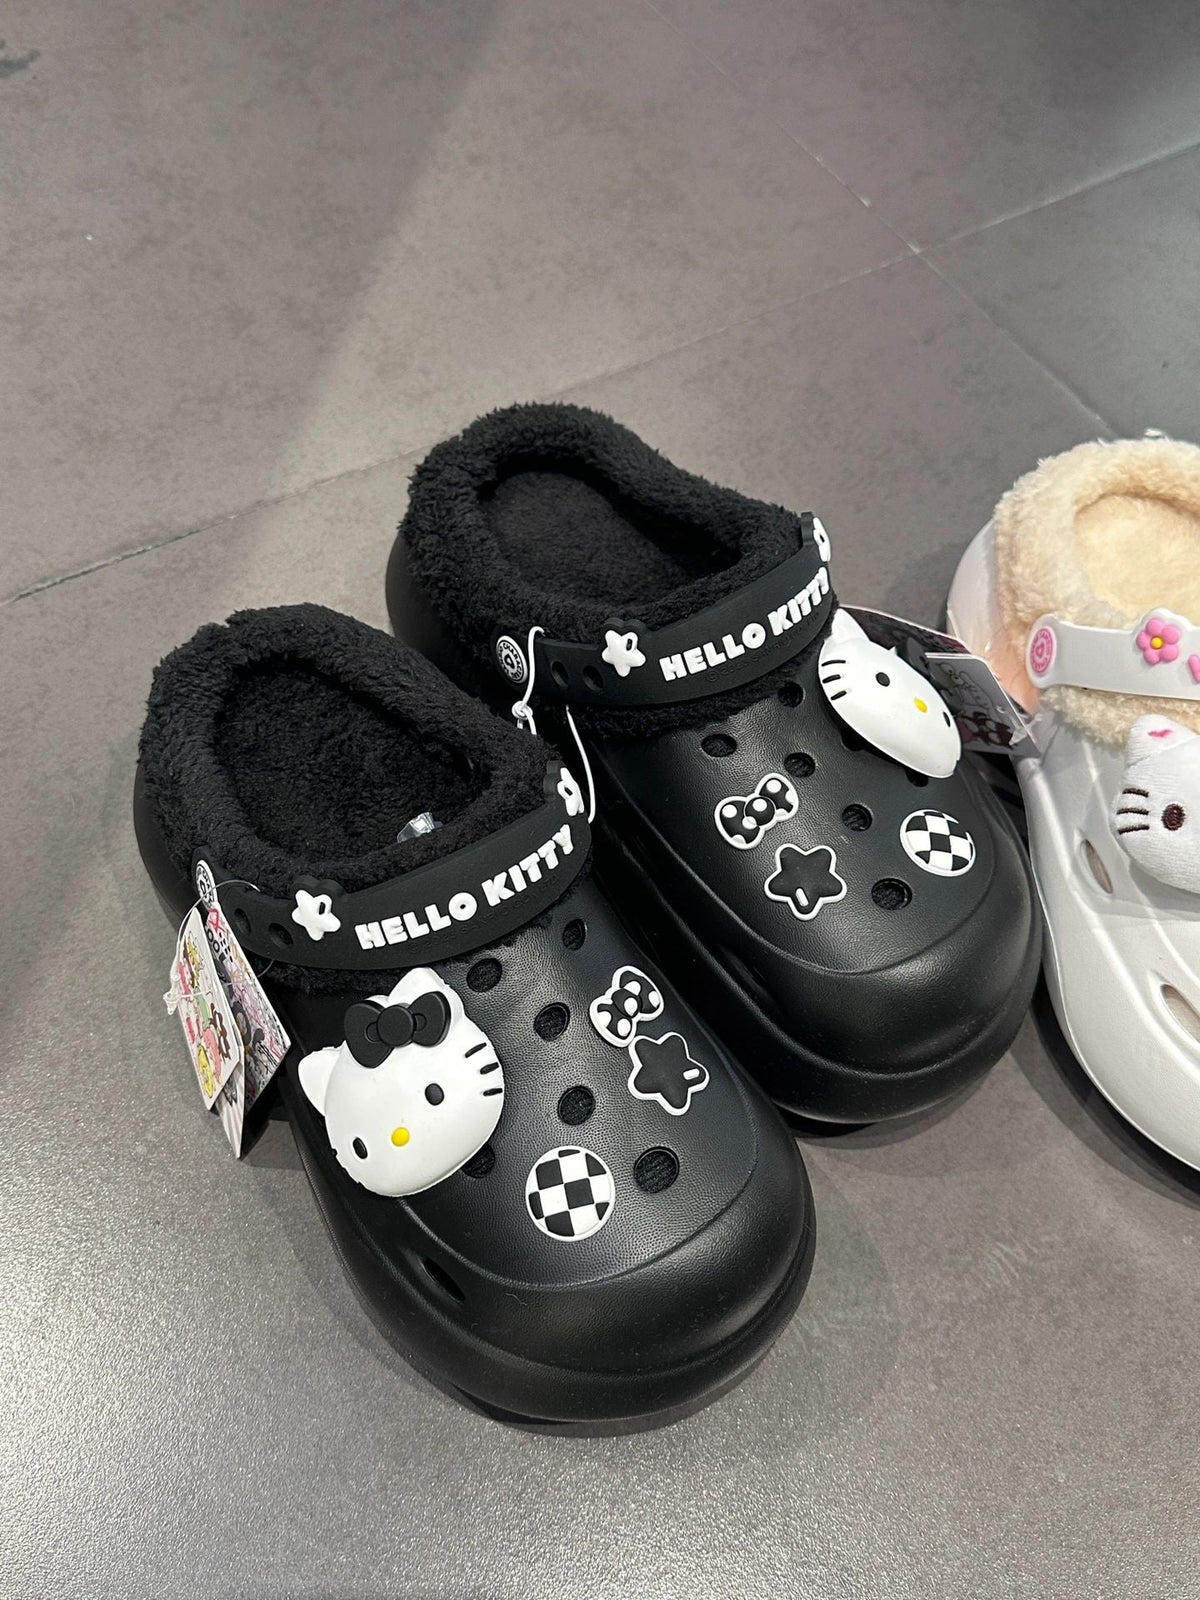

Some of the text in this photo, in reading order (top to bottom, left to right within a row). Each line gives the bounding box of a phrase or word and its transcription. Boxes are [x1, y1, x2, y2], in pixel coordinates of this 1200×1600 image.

[659, 622, 766, 682] HELLO
[767, 566, 830, 636] KITTY
[354, 892, 478, 950] HELLO
[481, 824, 574, 907] KITTY
